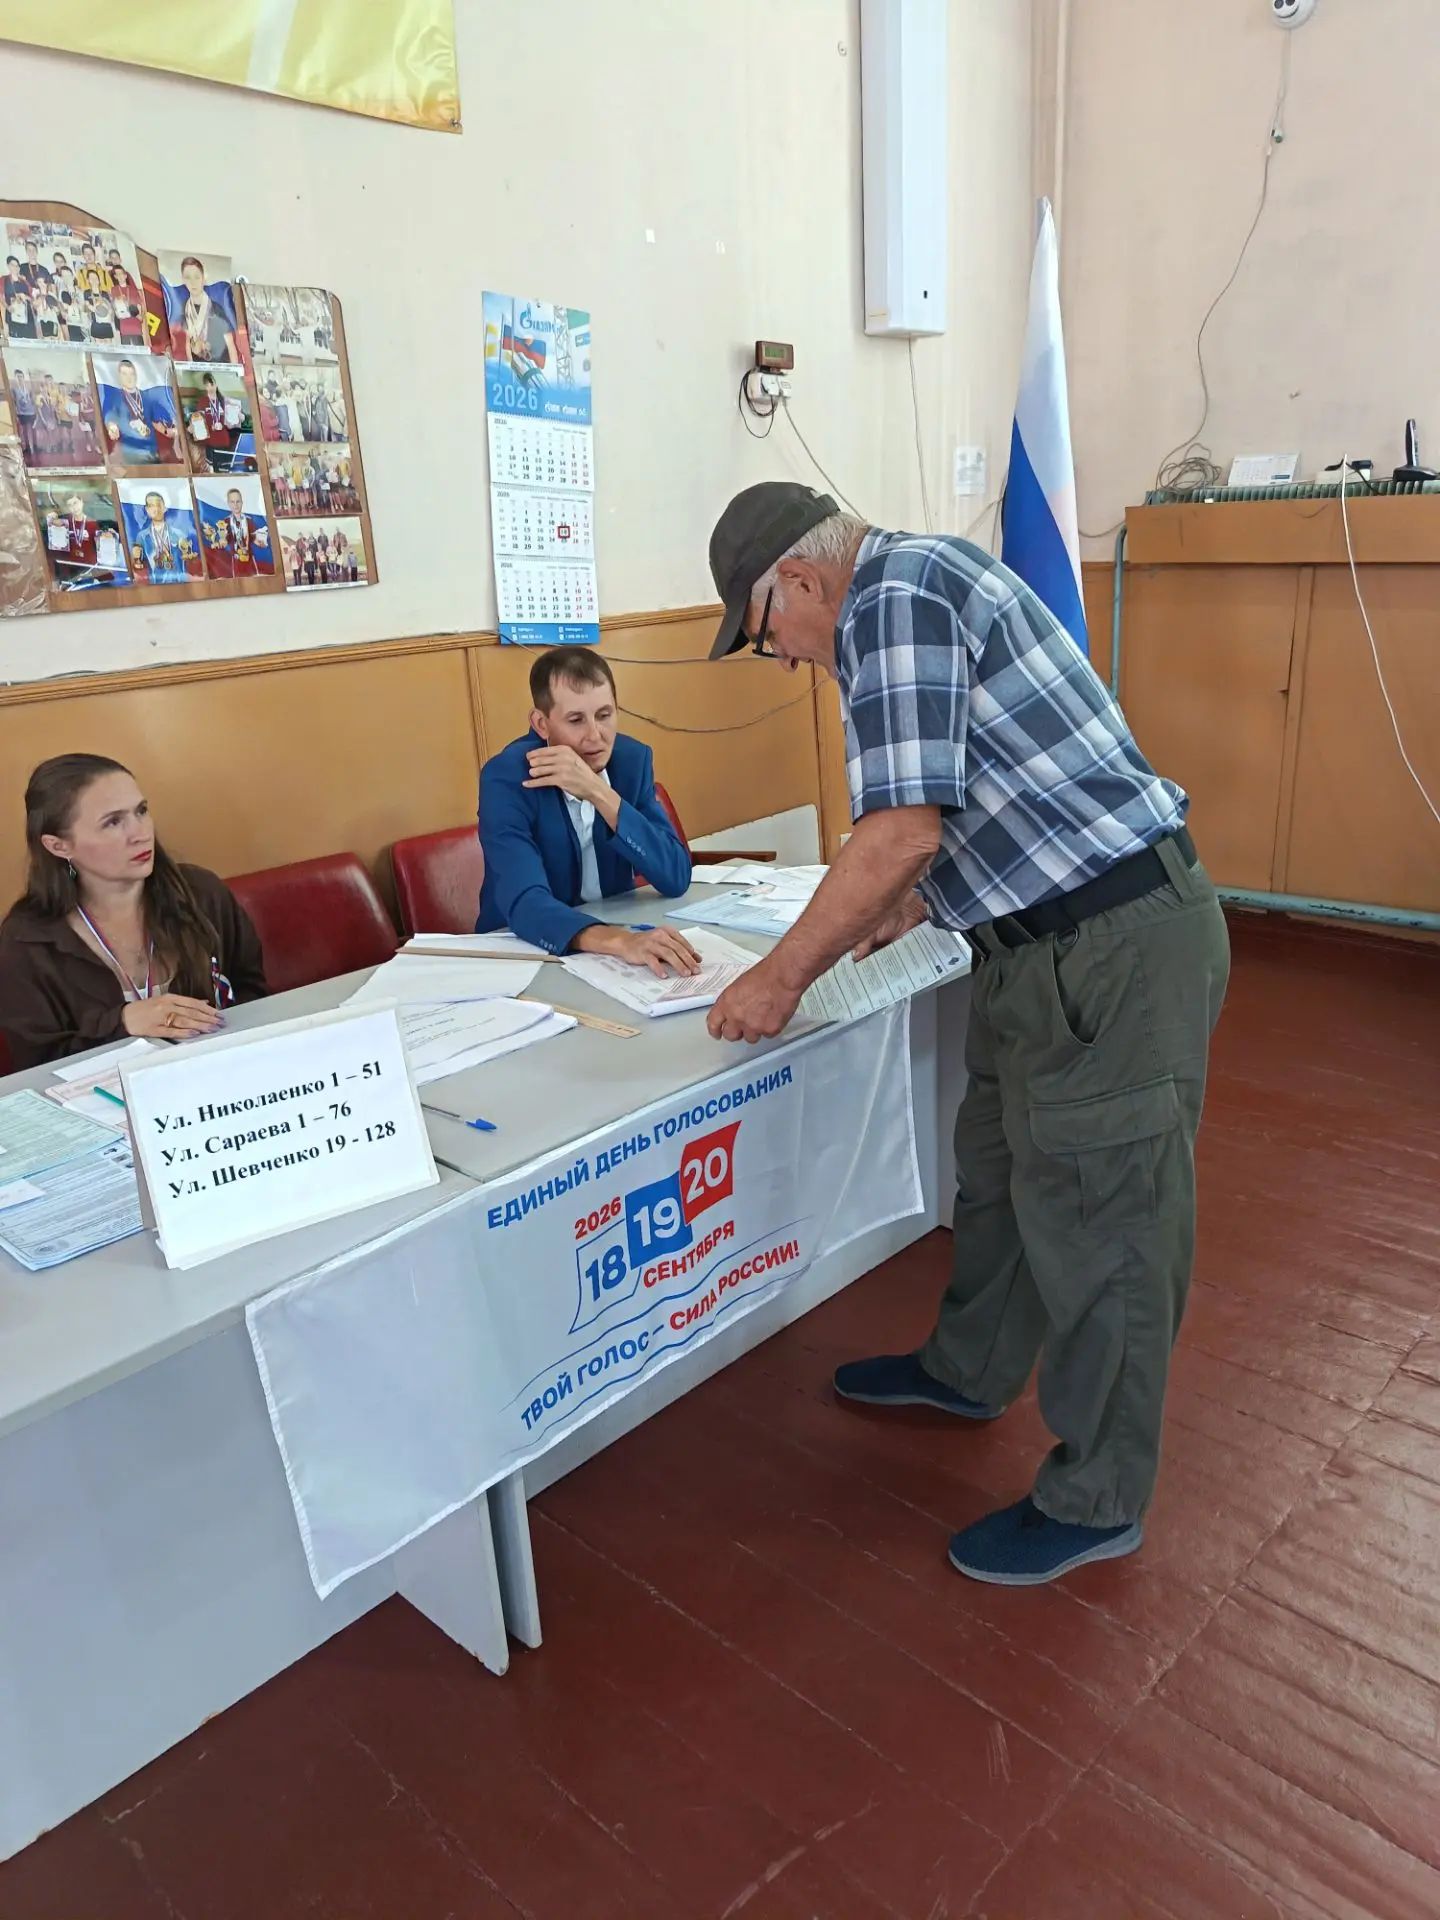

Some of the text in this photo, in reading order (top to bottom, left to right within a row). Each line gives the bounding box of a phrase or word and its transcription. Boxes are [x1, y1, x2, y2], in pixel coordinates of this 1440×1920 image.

[493, 383, 538, 411] 2026
[153, 1115, 192, 1134] Ул.
[198, 1079, 325, 1123] Николаенко
[331, 1072, 339, 1088] 1
[362, 1061, 382, 1079] 51
[161, 1148, 199, 1166] Ул.
[205, 1120, 291, 1154] Сараева
[298, 1113, 306, 1129] 1
[329, 1101, 352, 1120] 76
[168, 1180, 207, 1199] Ул.
[212, 1145, 320, 1187] Шевченко
[326, 1135, 346, 1154] 19
[365, 1120, 396, 1143] 128
[487, 1065, 793, 1229] ЕДИНЫЙ ДЕНЬ ГОЛОСОВАНИЯ
[574, 1196, 622, 1240] 2026
[585, 1146, 729, 1302] 18 19 20
[643, 1220, 735, 1288] СЕНТЯБРЯ
[520, 1372, 573, 1431] ТВОЙ
[577, 1331, 649, 1385] ГОЛОС
[669, 1289, 718, 1330] СИЛА
[718, 1240, 800, 1295] РОССИИ!
